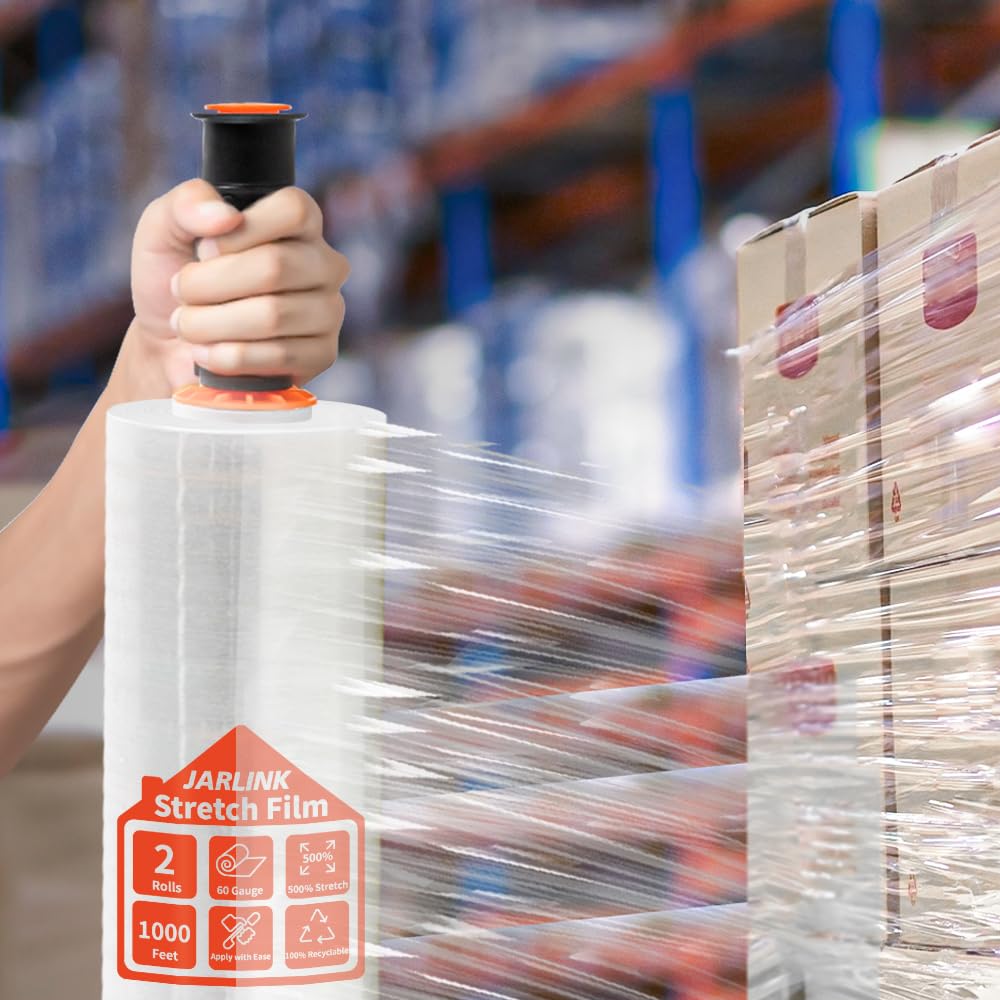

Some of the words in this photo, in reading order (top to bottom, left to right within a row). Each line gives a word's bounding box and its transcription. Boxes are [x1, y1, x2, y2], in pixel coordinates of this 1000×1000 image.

[183, 770, 291, 791] JARLINK
[154, 794, 258, 820] Stretch
[267, 795, 328, 820] Film
[154, 844, 175, 875] 2
[303, 851, 334, 863] 500%
[152, 880, 182, 893] Rolls
[217, 885, 229, 895] 60
[231, 885, 264, 897] Gauge
[288, 884, 314, 894] 500%
[315, 880, 349, 892] Stretch
[138, 920, 191, 943] 1000
[152, 949, 179, 961] Feet
[210, 952, 233, 962] Apply
[234, 951, 252, 961] with
[253, 952, 271, 961] Ease
[285, 951, 307, 960] 100%
